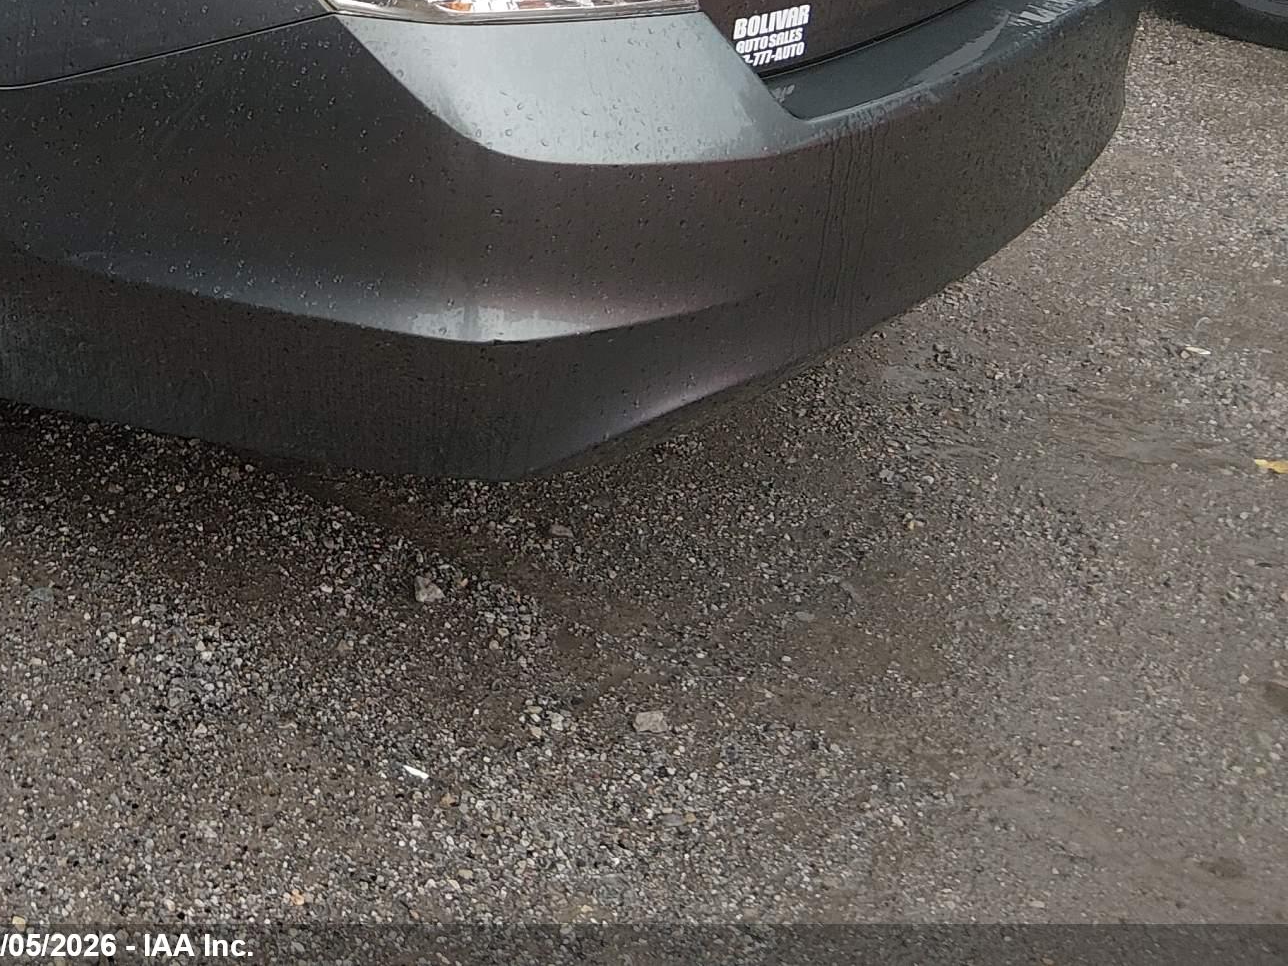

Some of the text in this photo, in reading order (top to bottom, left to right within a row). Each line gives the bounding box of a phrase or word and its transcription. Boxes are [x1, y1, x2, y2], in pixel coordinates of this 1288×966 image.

[733, 4, 811, 40] BOLIVAR
[735, 27, 804, 54] AUTO SALES
